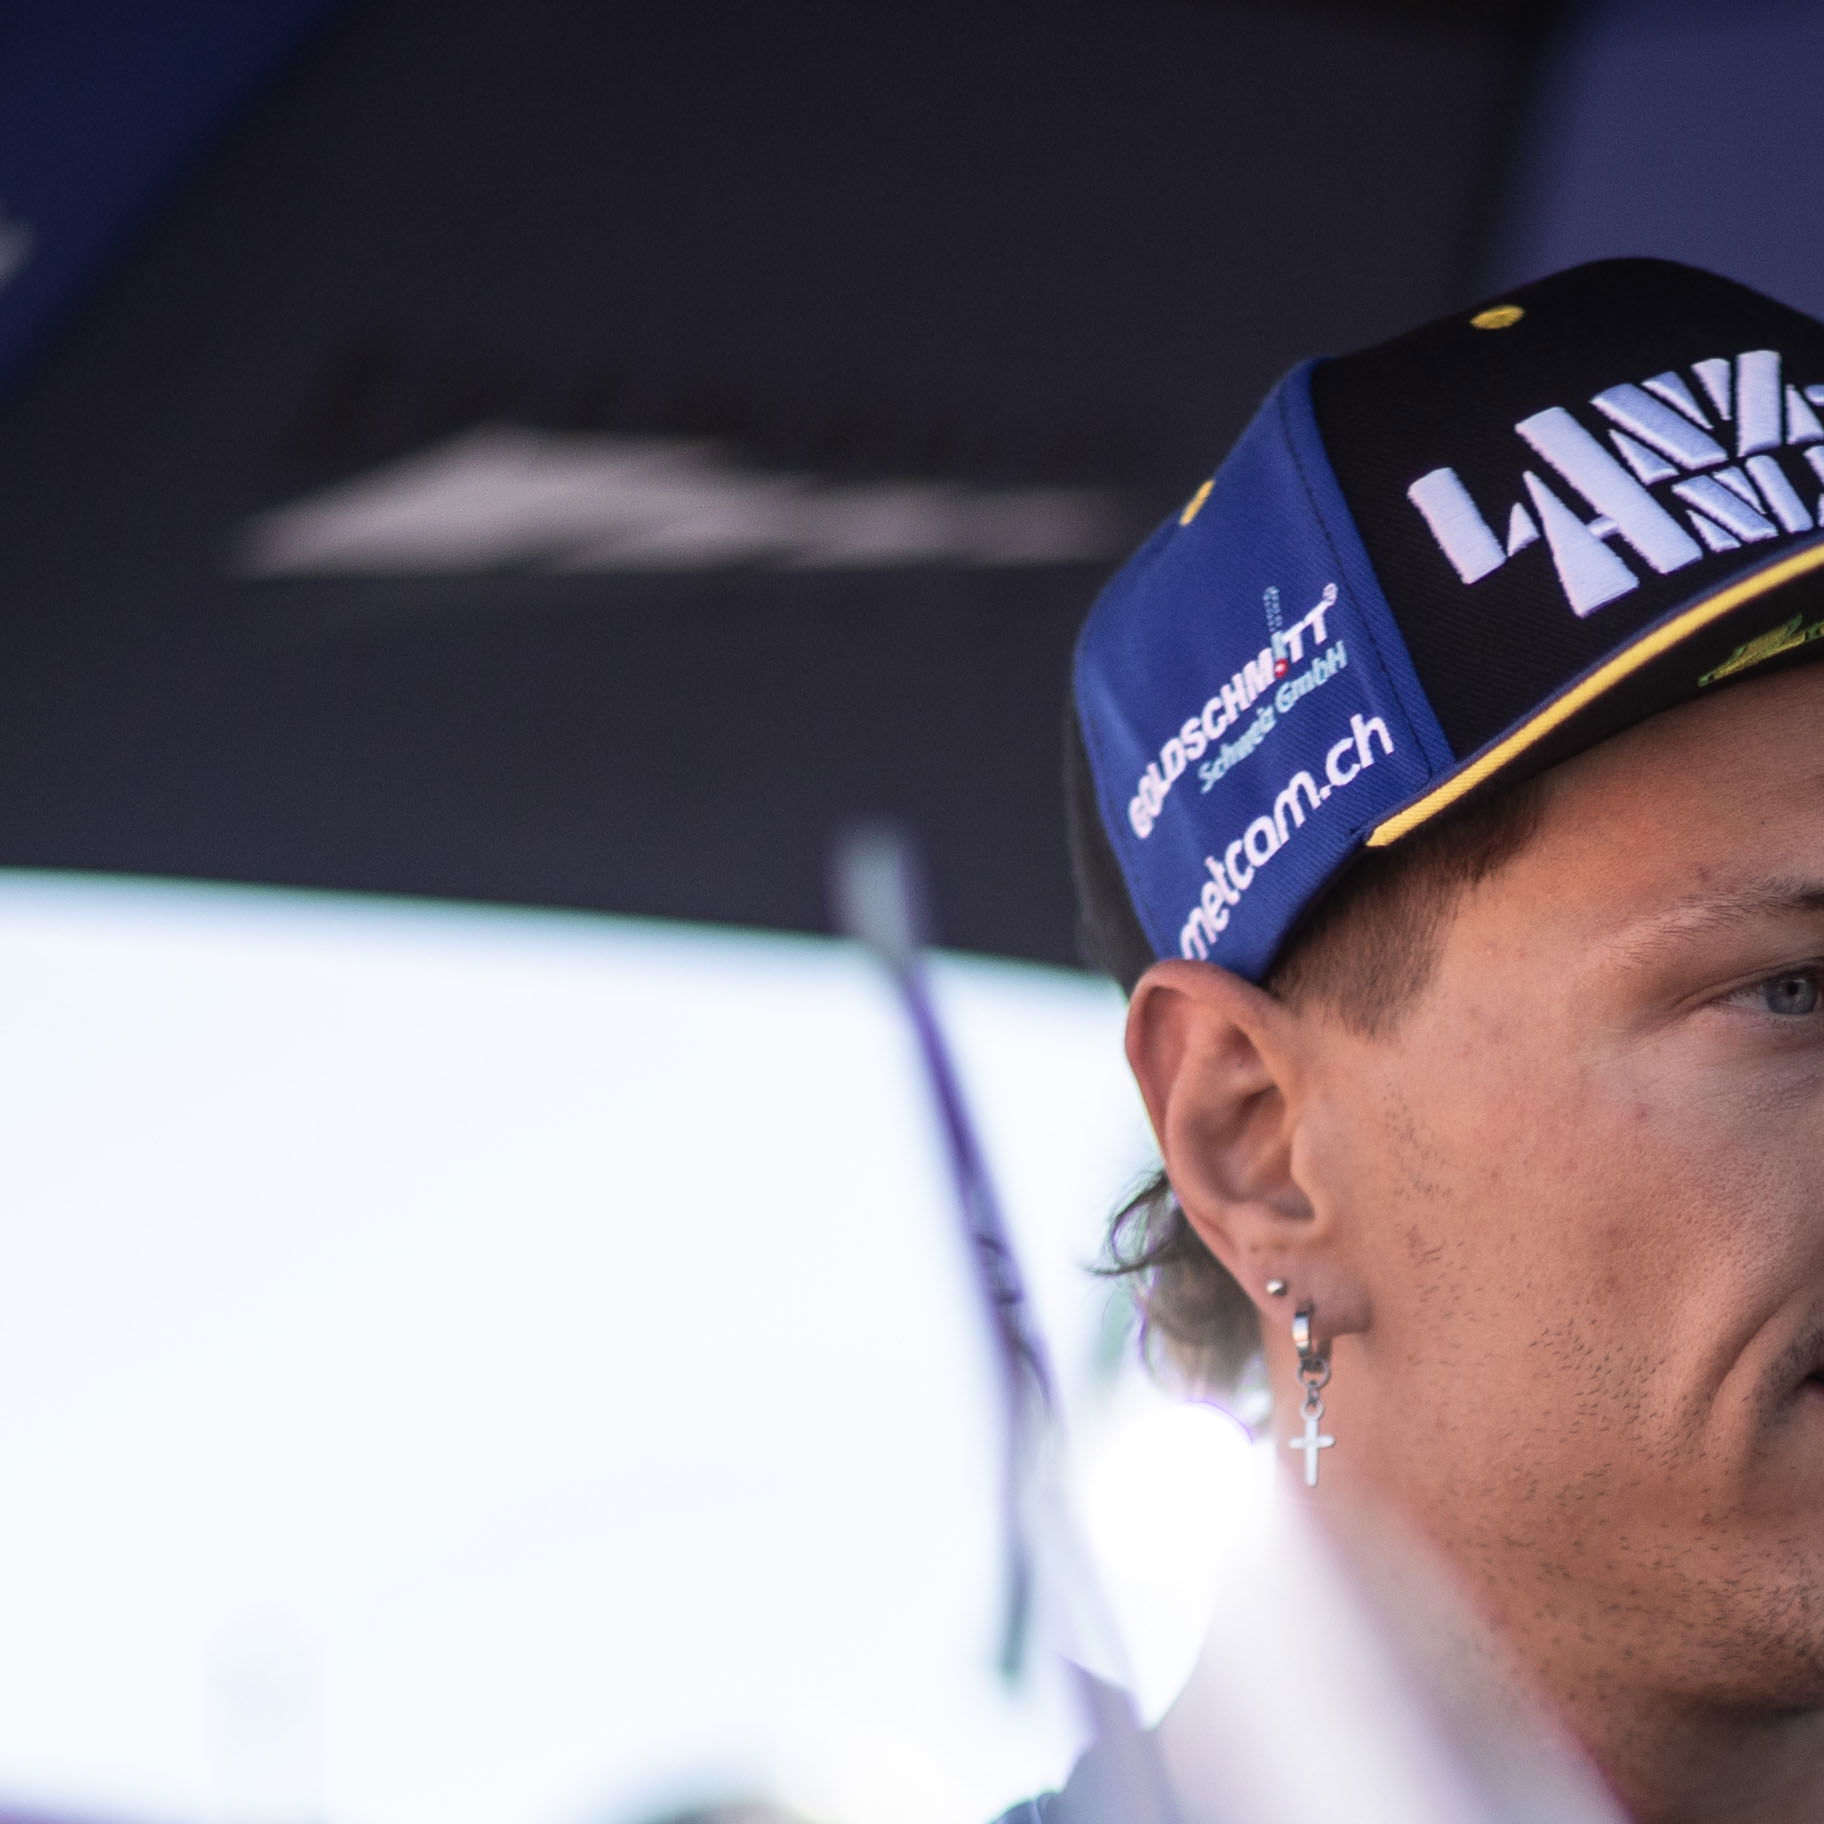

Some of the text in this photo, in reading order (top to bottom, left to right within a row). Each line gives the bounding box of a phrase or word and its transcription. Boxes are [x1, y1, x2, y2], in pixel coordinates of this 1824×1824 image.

[1199, 640, 1348, 794] Schweiz GmbH
[1180, 713, 1394, 962] metcam.ch
